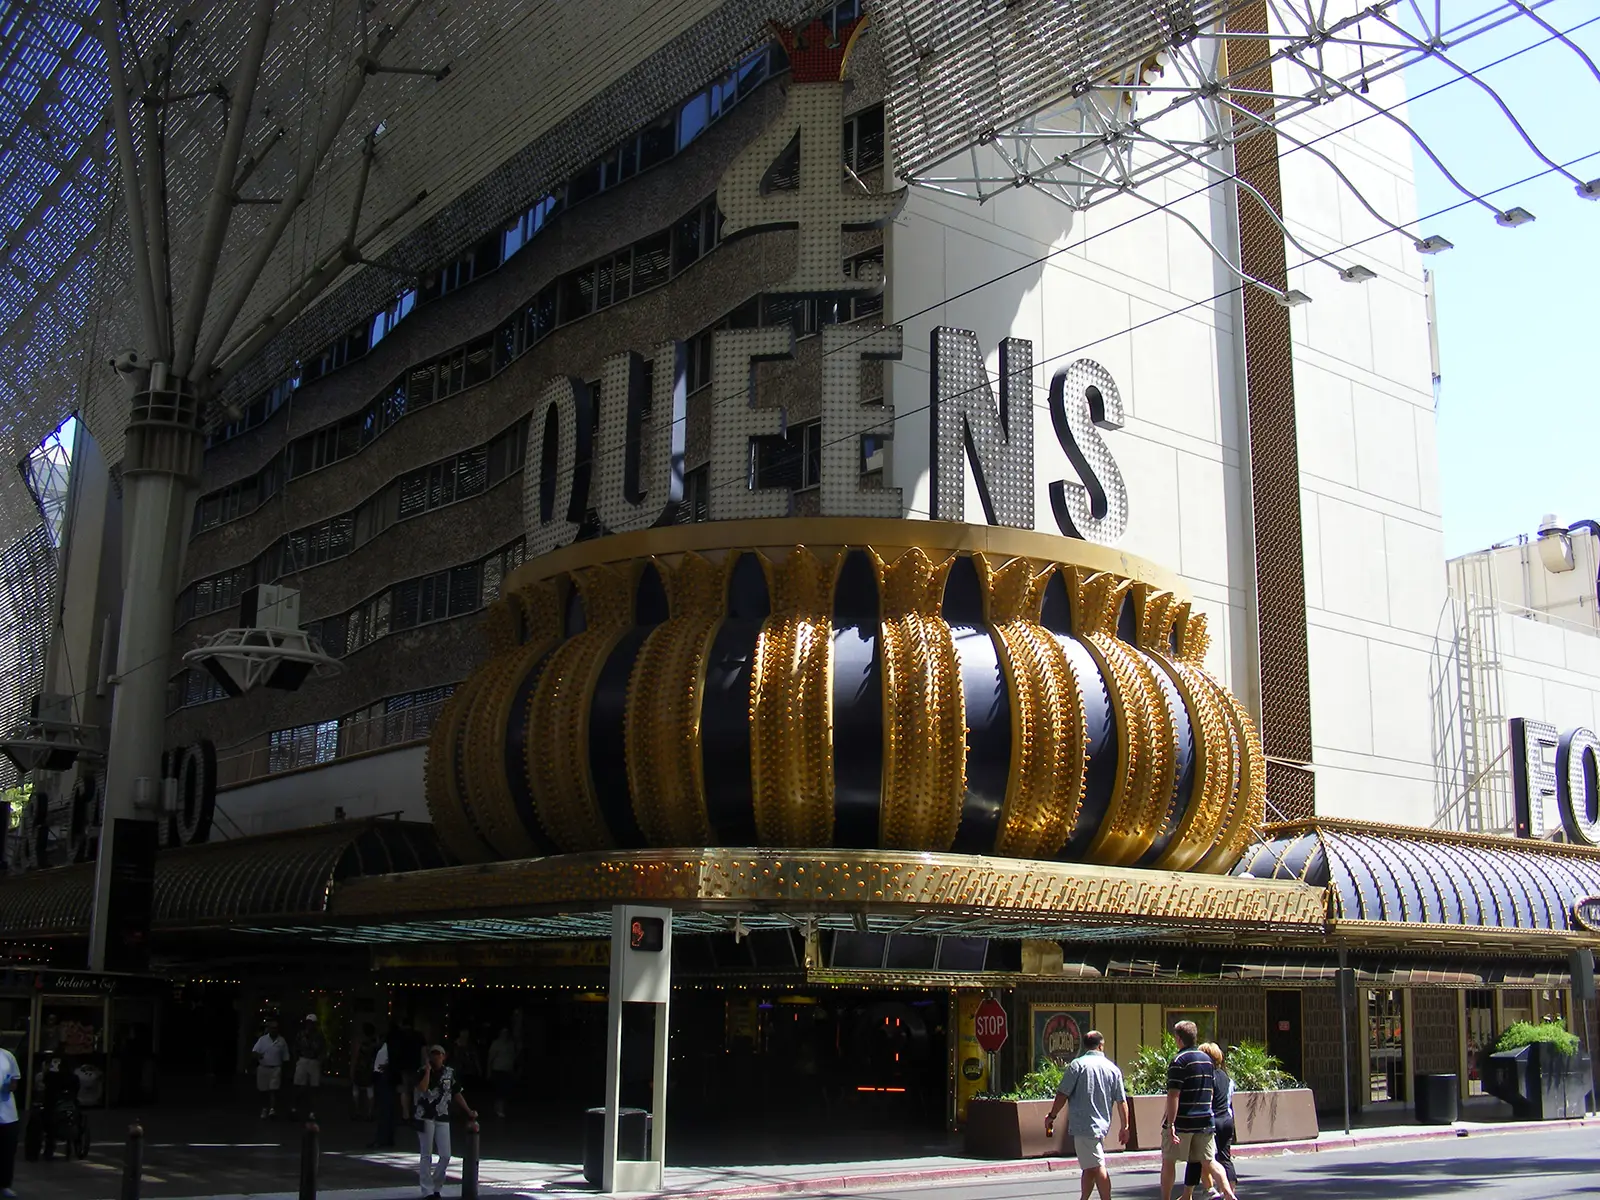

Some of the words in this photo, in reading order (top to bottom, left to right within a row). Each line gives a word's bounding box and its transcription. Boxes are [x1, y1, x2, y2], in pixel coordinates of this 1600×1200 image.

[717, 81, 908, 297] 4
[524, 325, 1129, 550] QUEENS
[55, 975, 91, 989] Gelato
[977, 1016, 1004, 1036] STOP
